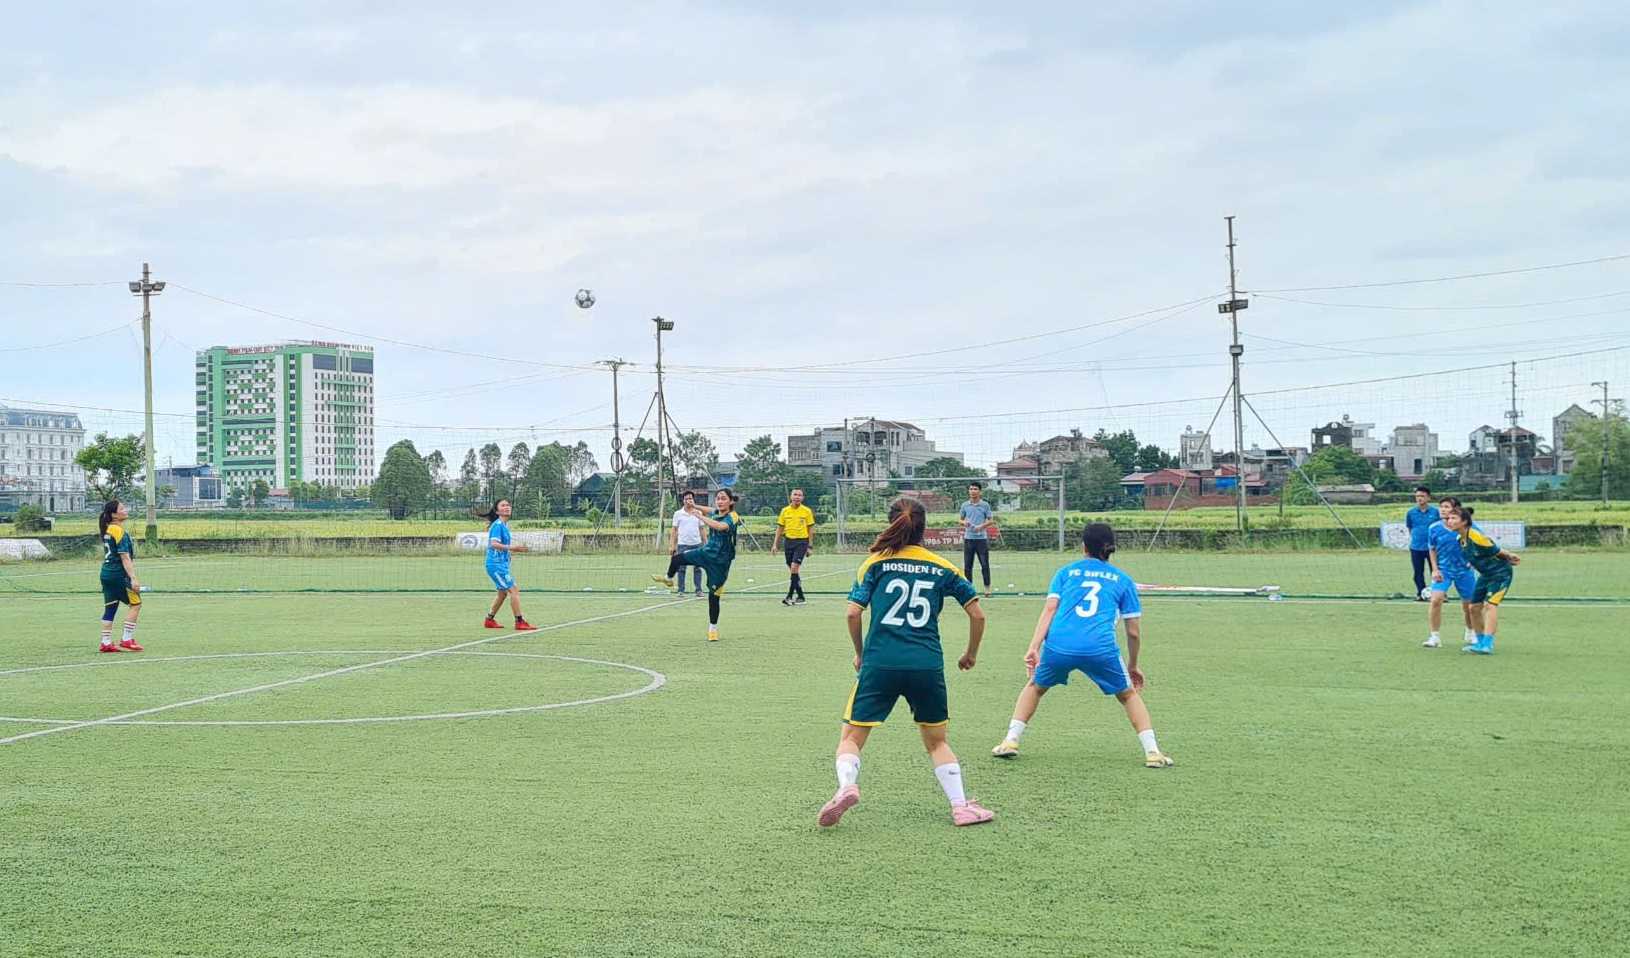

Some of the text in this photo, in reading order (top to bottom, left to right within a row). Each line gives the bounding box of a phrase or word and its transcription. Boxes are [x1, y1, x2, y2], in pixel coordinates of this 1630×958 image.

[882, 562, 944, 576] HOSIDEN FC
[1068, 568, 1081, 577] FC
[881, 578, 936, 628] 25
[1075, 581, 1103, 618] 3
